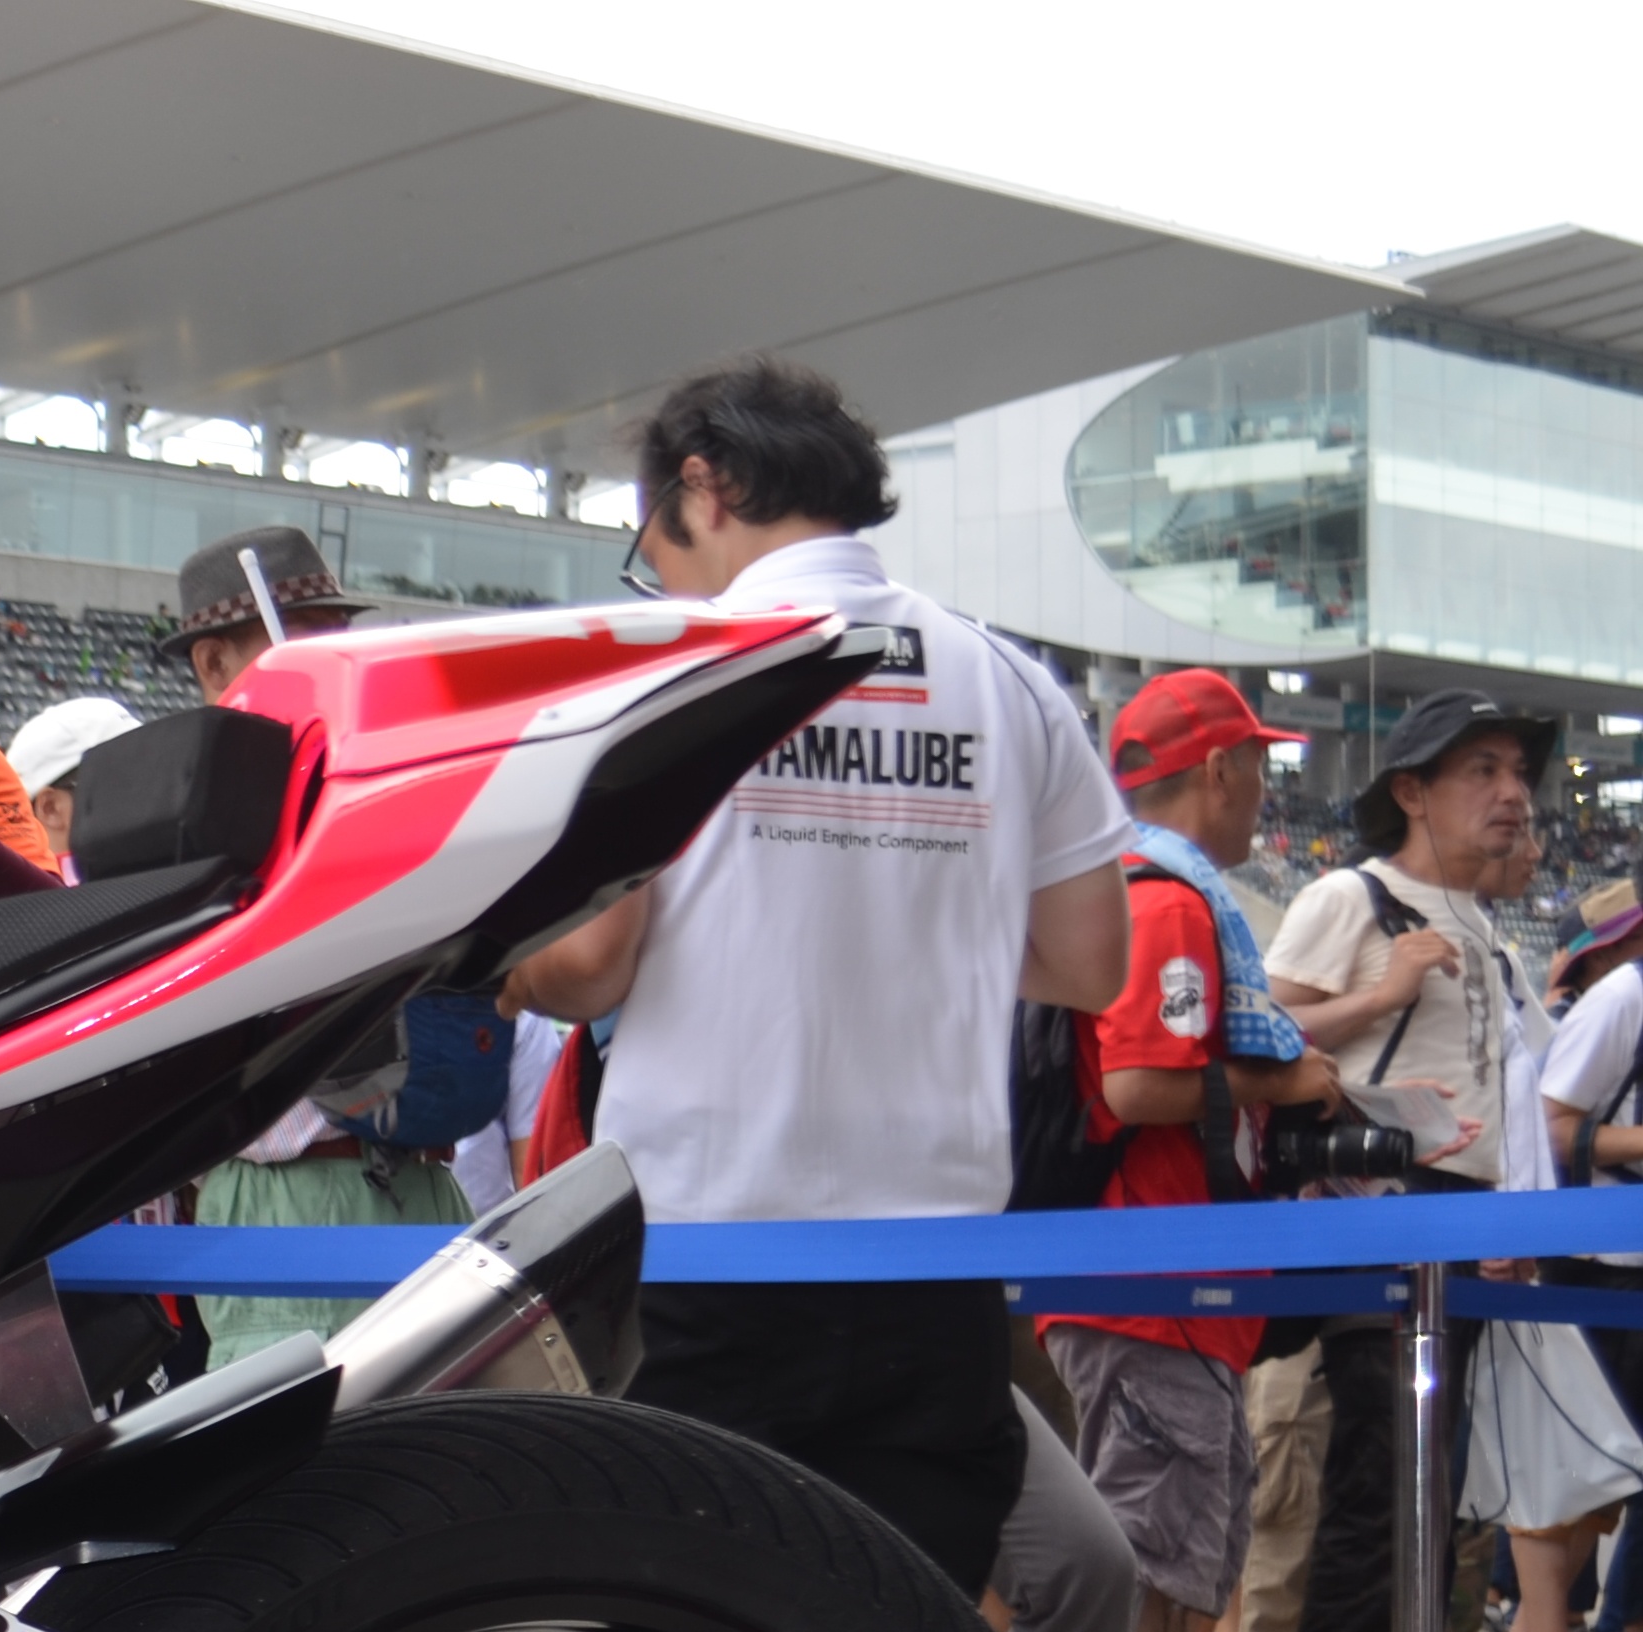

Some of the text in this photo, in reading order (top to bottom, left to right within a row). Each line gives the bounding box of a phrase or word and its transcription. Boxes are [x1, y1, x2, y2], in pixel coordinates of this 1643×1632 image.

[752, 824, 970, 855] A Liquid Engine Component
